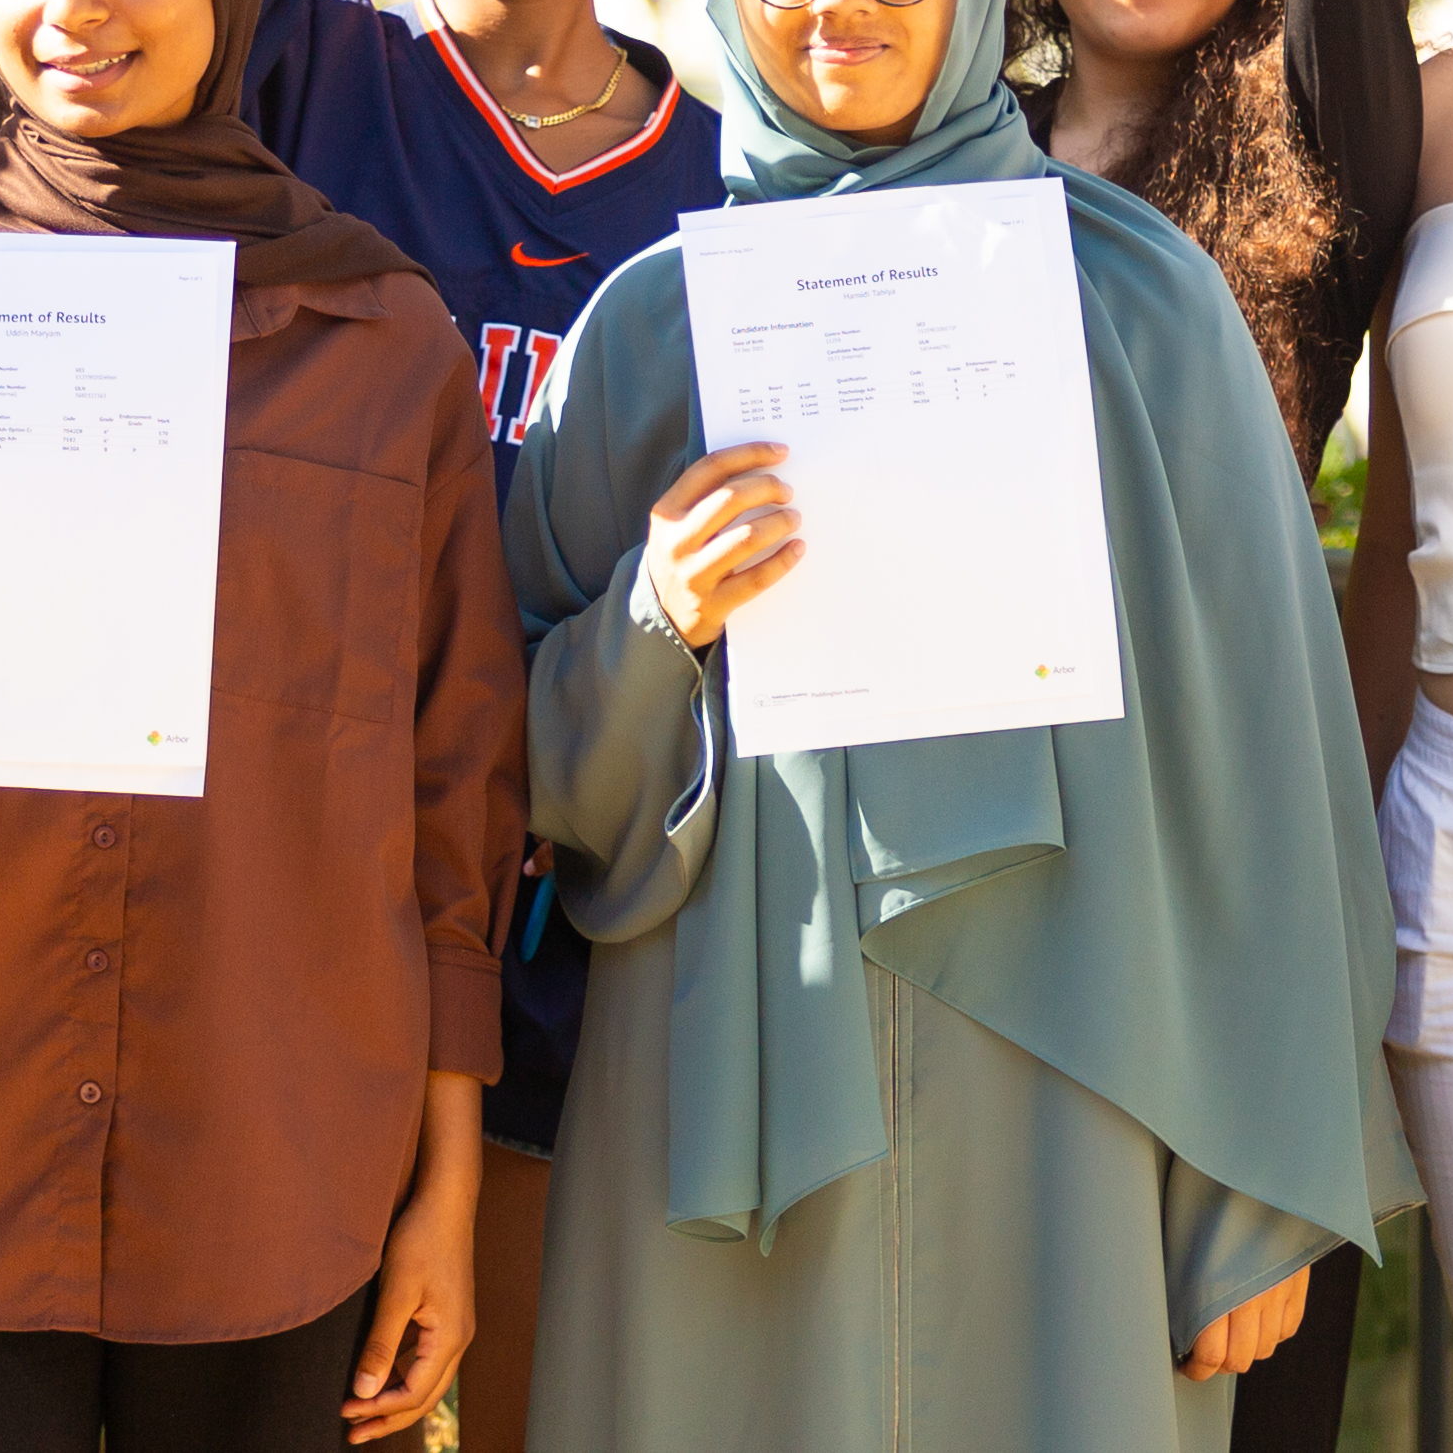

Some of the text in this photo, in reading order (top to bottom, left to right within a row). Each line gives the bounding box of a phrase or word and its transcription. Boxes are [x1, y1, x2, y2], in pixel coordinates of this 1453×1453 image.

[796, 267, 938, 292] Statement of Results
[38, 311, 53, 323] of
[56, 312, 106, 324] Results
[731, 321, 814, 335] Candidate Information
[1053, 666, 1076, 675] Arbor
[165, 734, 190, 744] Arbor
